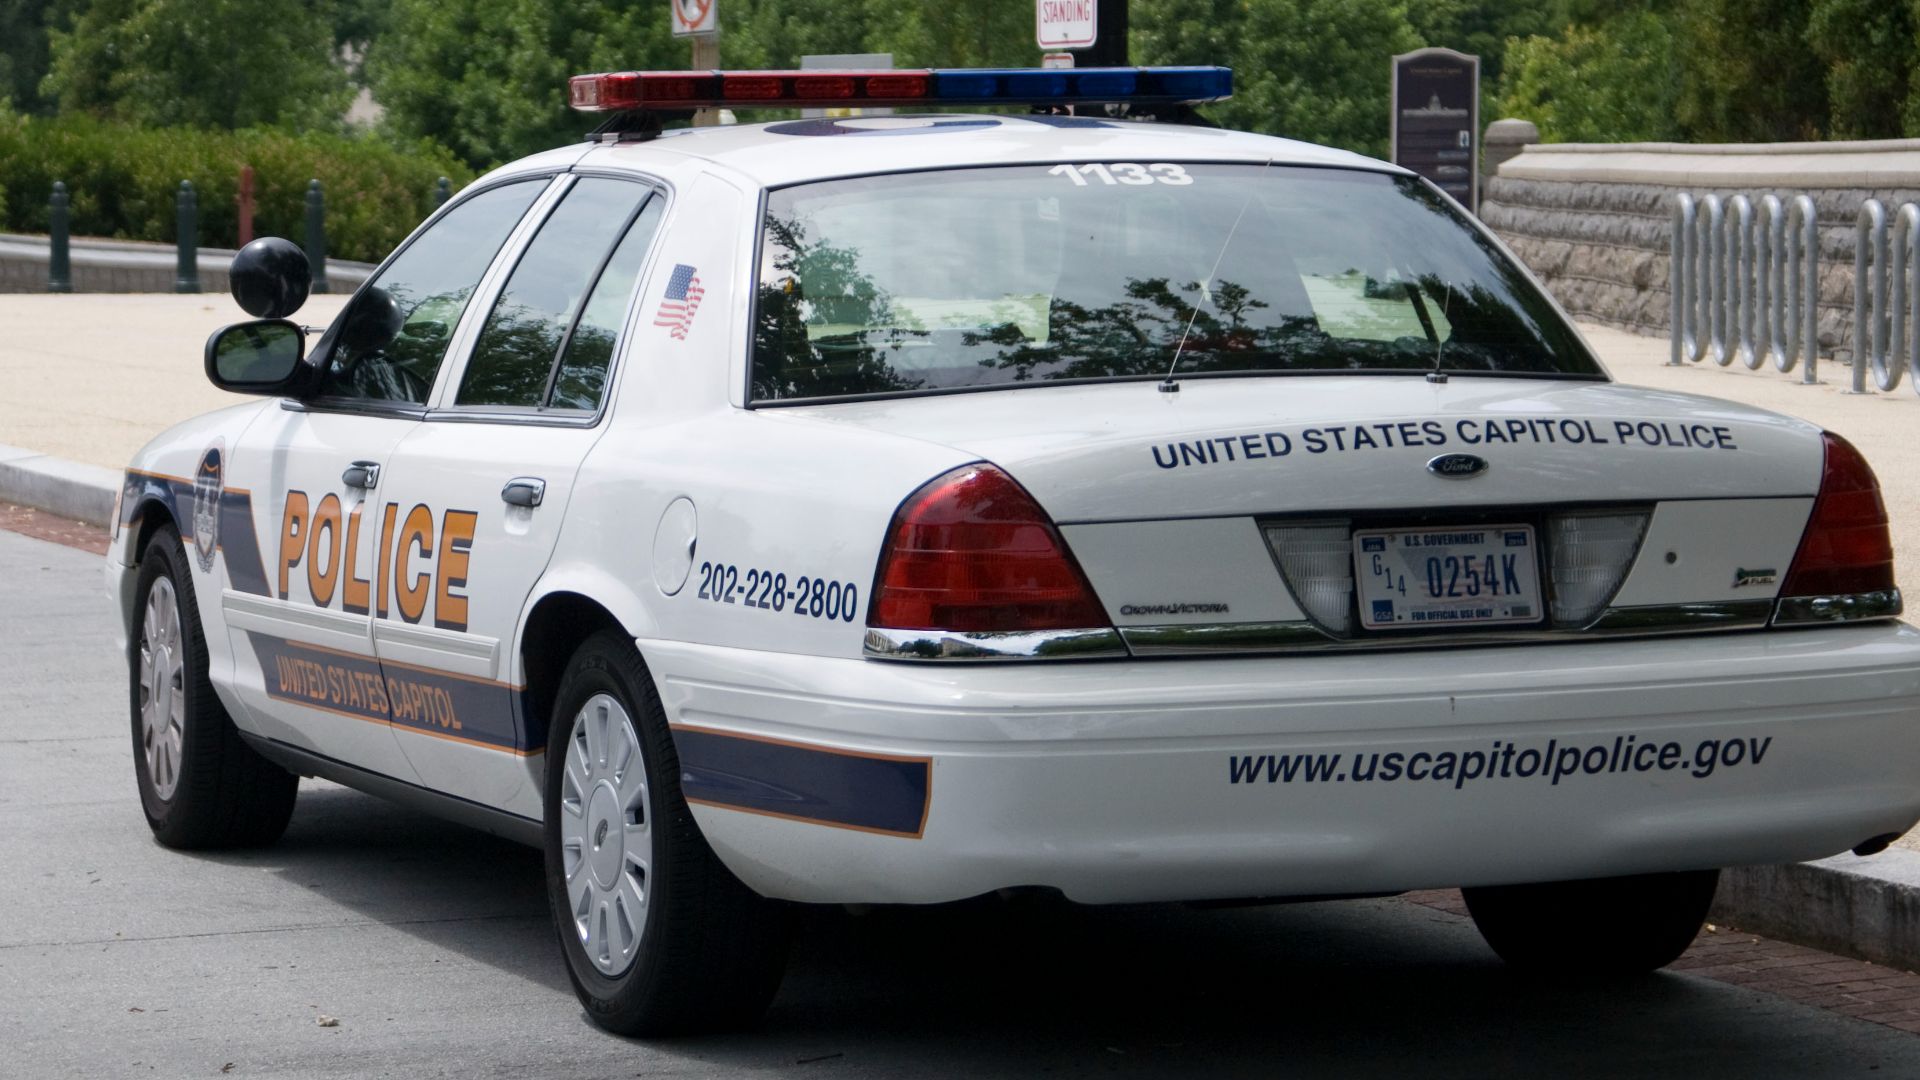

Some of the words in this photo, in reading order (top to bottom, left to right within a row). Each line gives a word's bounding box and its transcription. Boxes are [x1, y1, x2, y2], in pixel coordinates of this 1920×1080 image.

[1043, 0, 1090, 23] STANDING
[1048, 162, 1194, 186] 1133
[1152, 432, 1293, 470] UNITED
[1304, 421, 1447, 453] STATES
[1455, 418, 1607, 446] CAPITOL
[1615, 420, 1738, 450] POLICE
[278, 489, 478, 632] POLICE
[1404, 534, 1423, 547] U.S.
[1423, 532, 1486, 546] GOVERNMENT
[698, 561, 858, 623] 202-228-2800
[1426, 553, 1521, 598] 0254K
[1411, 611, 1426, 621] FOR
[1427, 610, 1459, 620] OFFICIAL
[1460, 609, 1474, 619] USE
[1475, 608, 1493, 618] ONLY
[275, 655, 328, 700] UNITED
[327, 664, 389, 714] STATES
[388, 677, 463, 730] CAPITOL
[1228, 735, 1772, 789] www.uscapitolpolice.gov
